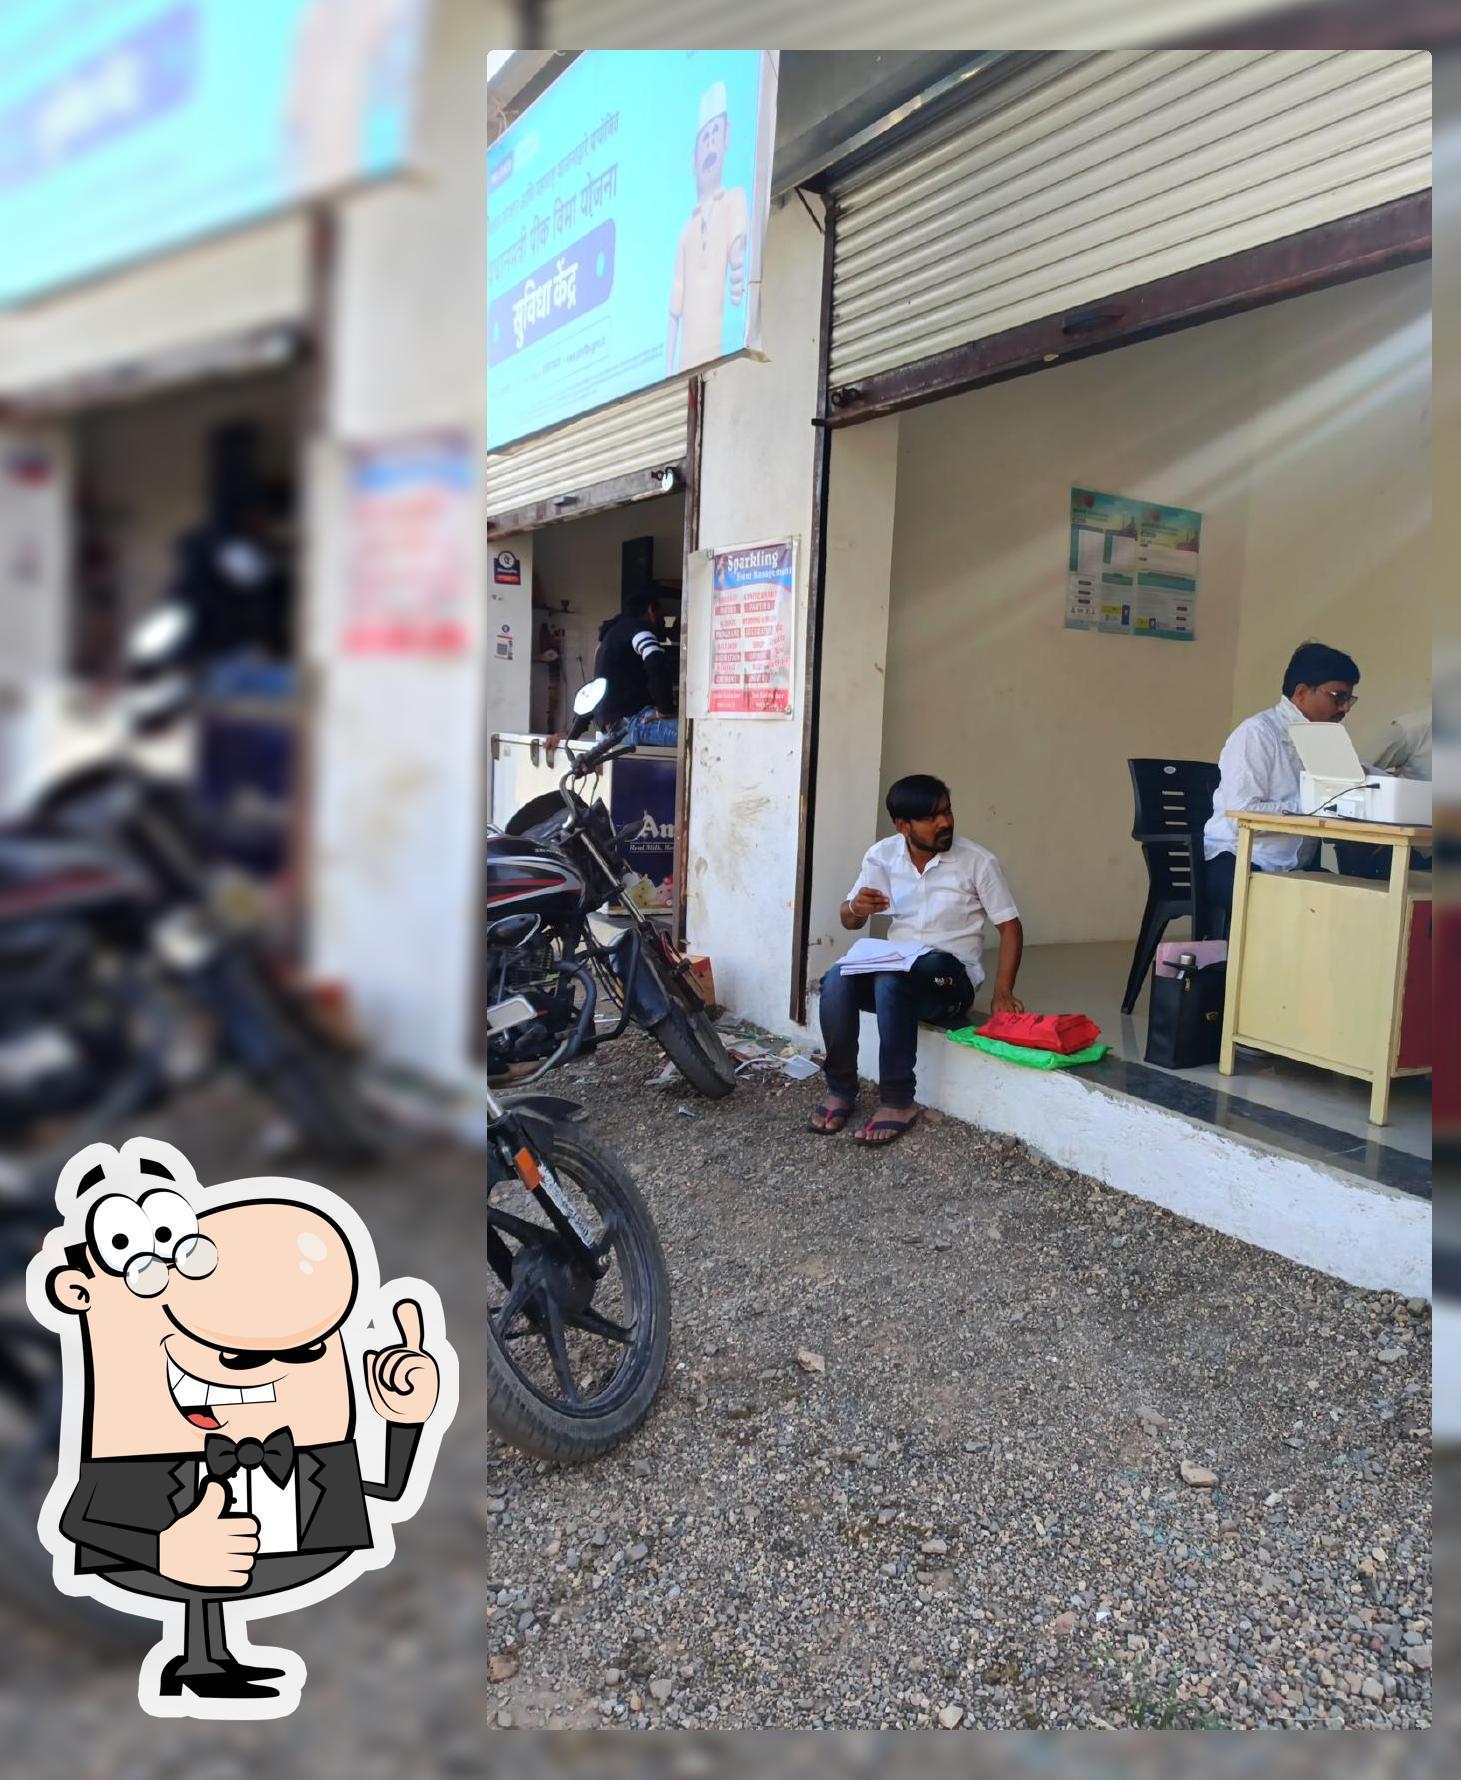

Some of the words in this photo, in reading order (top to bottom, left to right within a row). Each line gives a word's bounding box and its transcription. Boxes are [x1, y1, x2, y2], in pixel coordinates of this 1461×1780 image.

[580, 162, 618, 216] योजना
[512, 279, 552, 349] सुविधा
[553, 256, 579, 310] केंद्र
[728, 550, 778, 574] Sparkling
